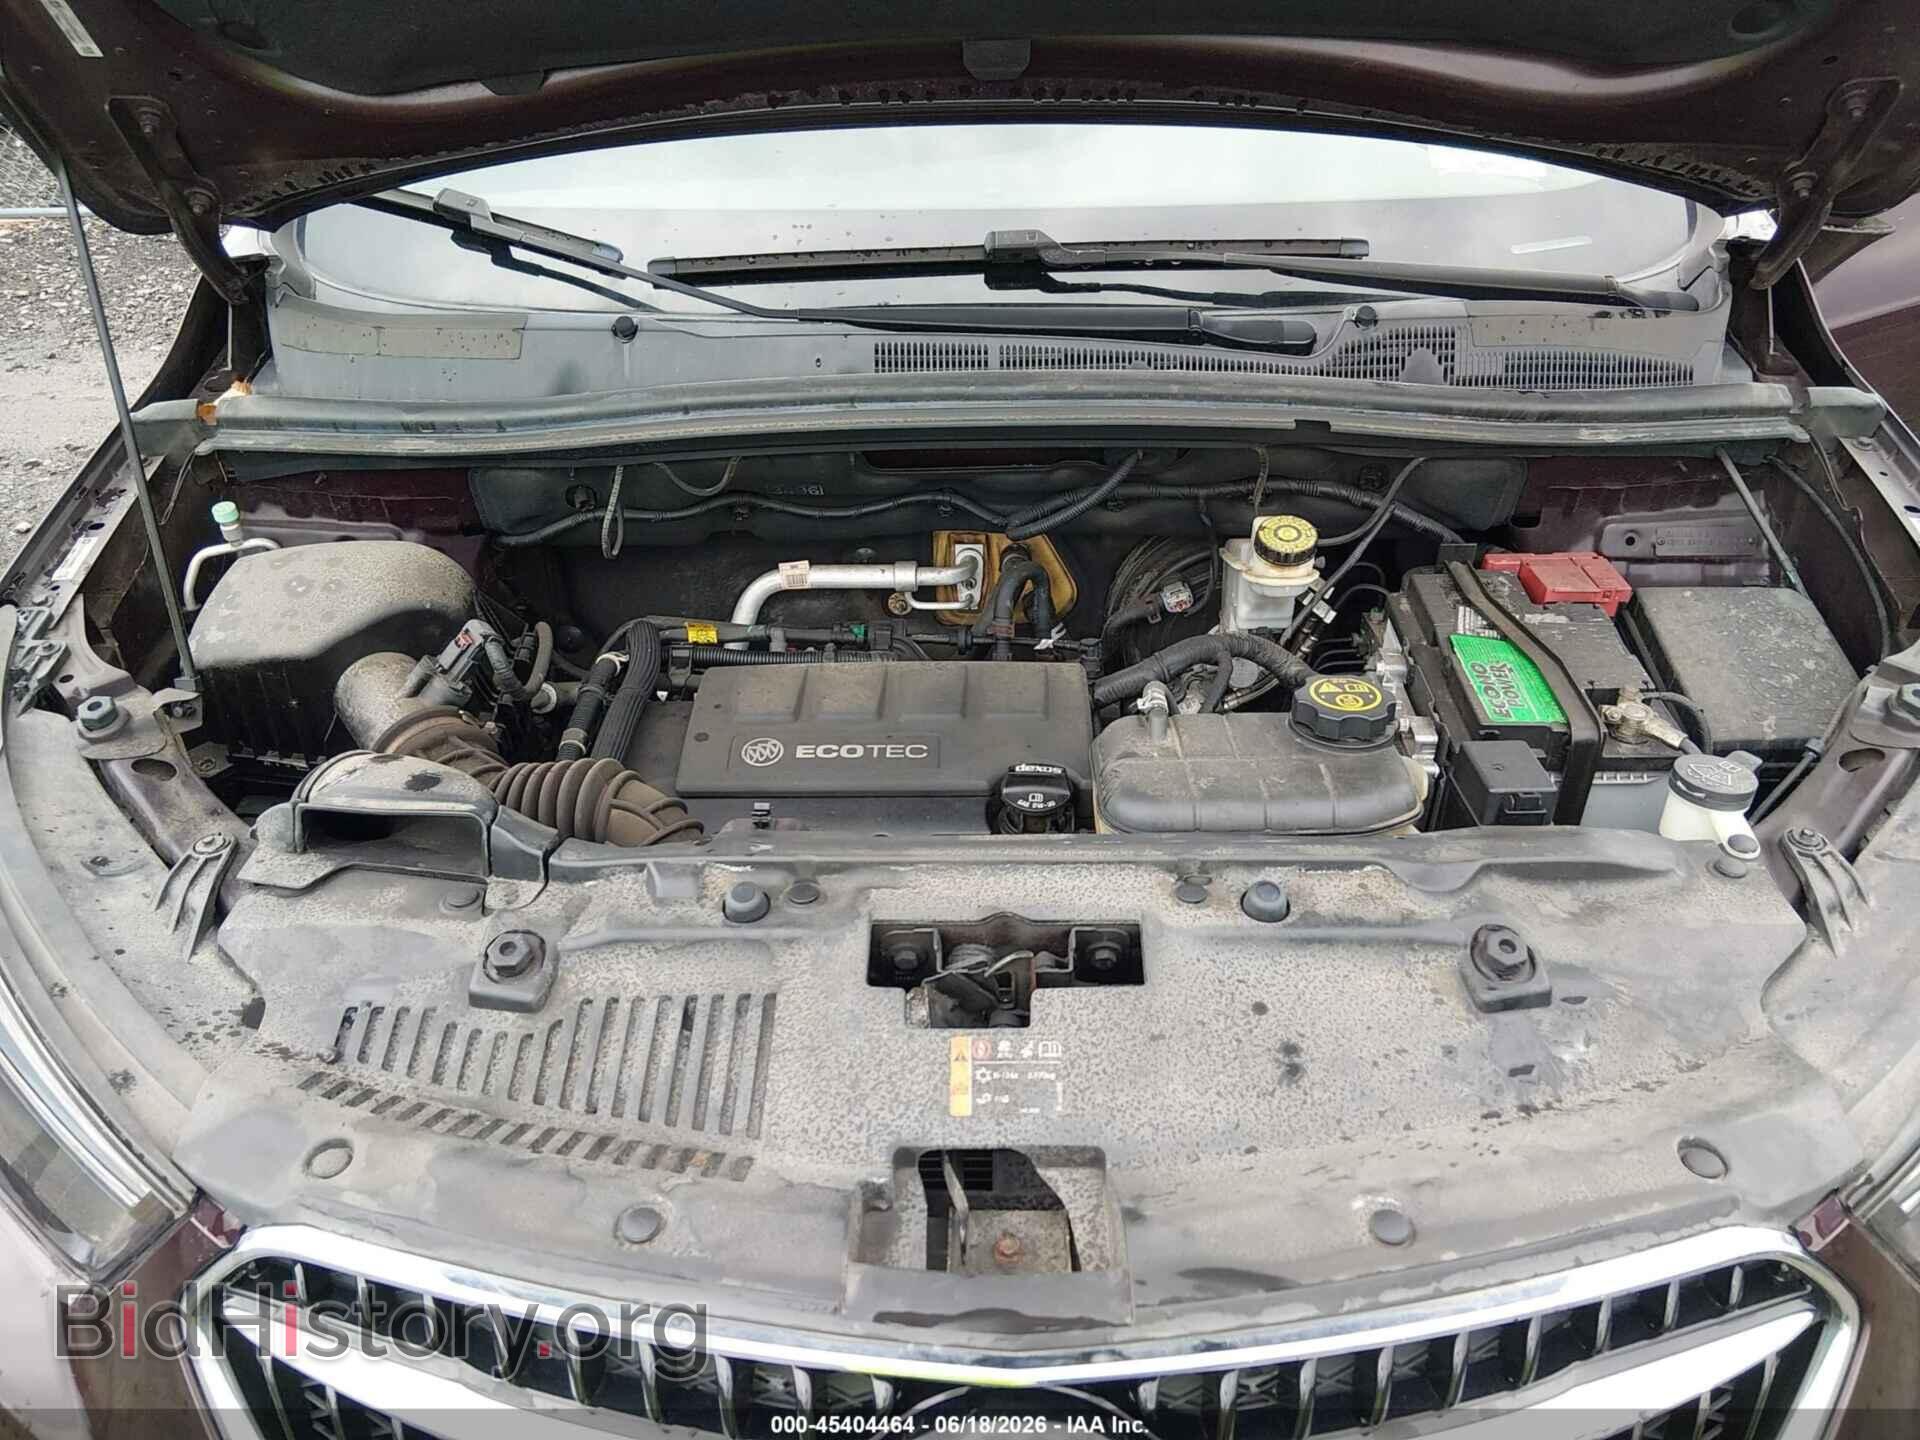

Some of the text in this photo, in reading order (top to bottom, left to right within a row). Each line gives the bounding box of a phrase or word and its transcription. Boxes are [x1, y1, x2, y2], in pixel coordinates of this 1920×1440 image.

[1470, 661, 1512, 719] ECONO
[1489, 662, 1525, 708] POWER
[795, 744, 929, 759] ECOTEC
[1015, 763, 1062, 774] dexos
